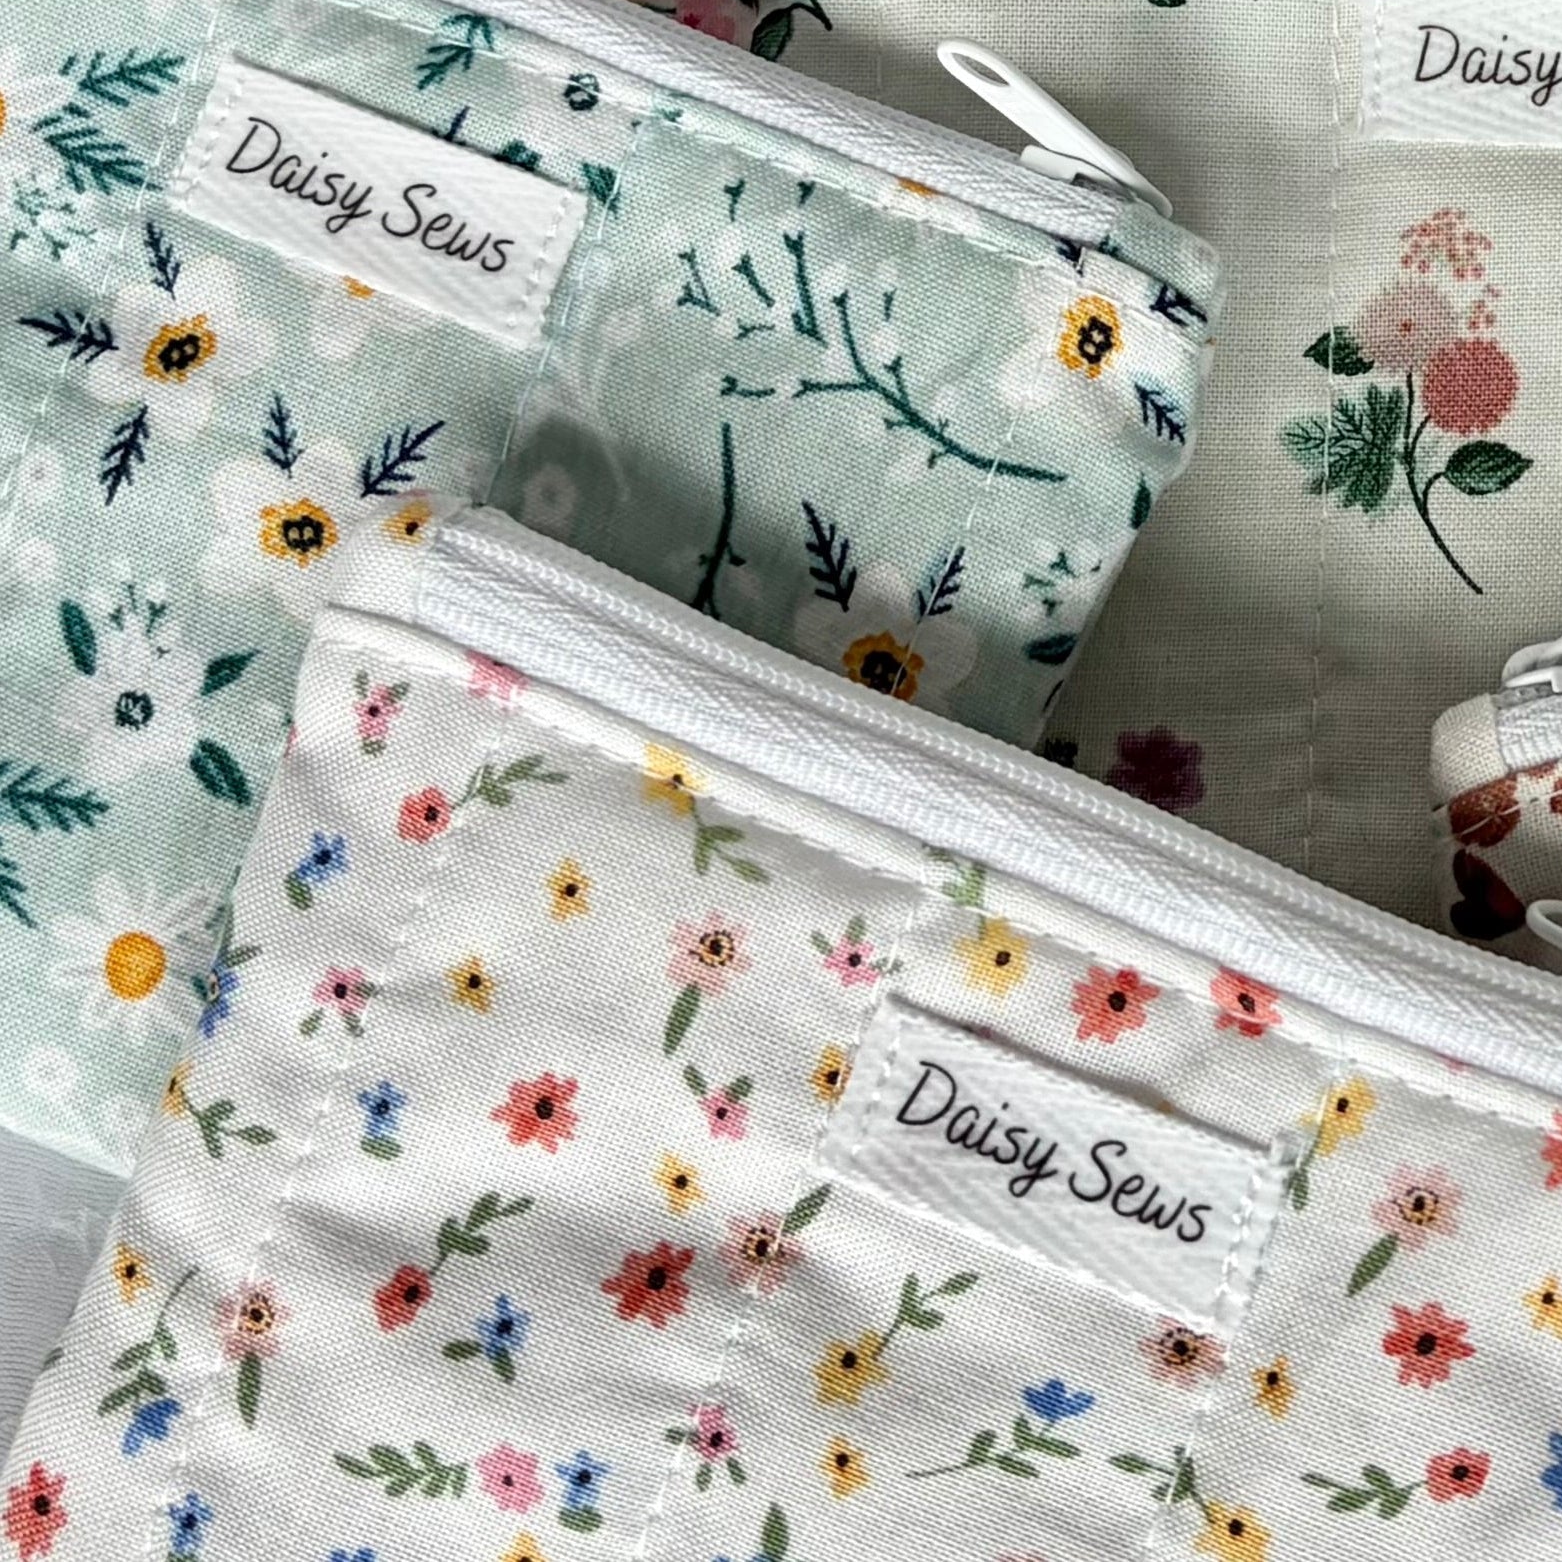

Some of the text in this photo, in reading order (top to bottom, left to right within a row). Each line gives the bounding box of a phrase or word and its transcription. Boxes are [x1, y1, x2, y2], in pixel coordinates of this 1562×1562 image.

[225, 116, 515, 273] Daisy Sews
[895, 1060, 1213, 1242] Daisy Sews
